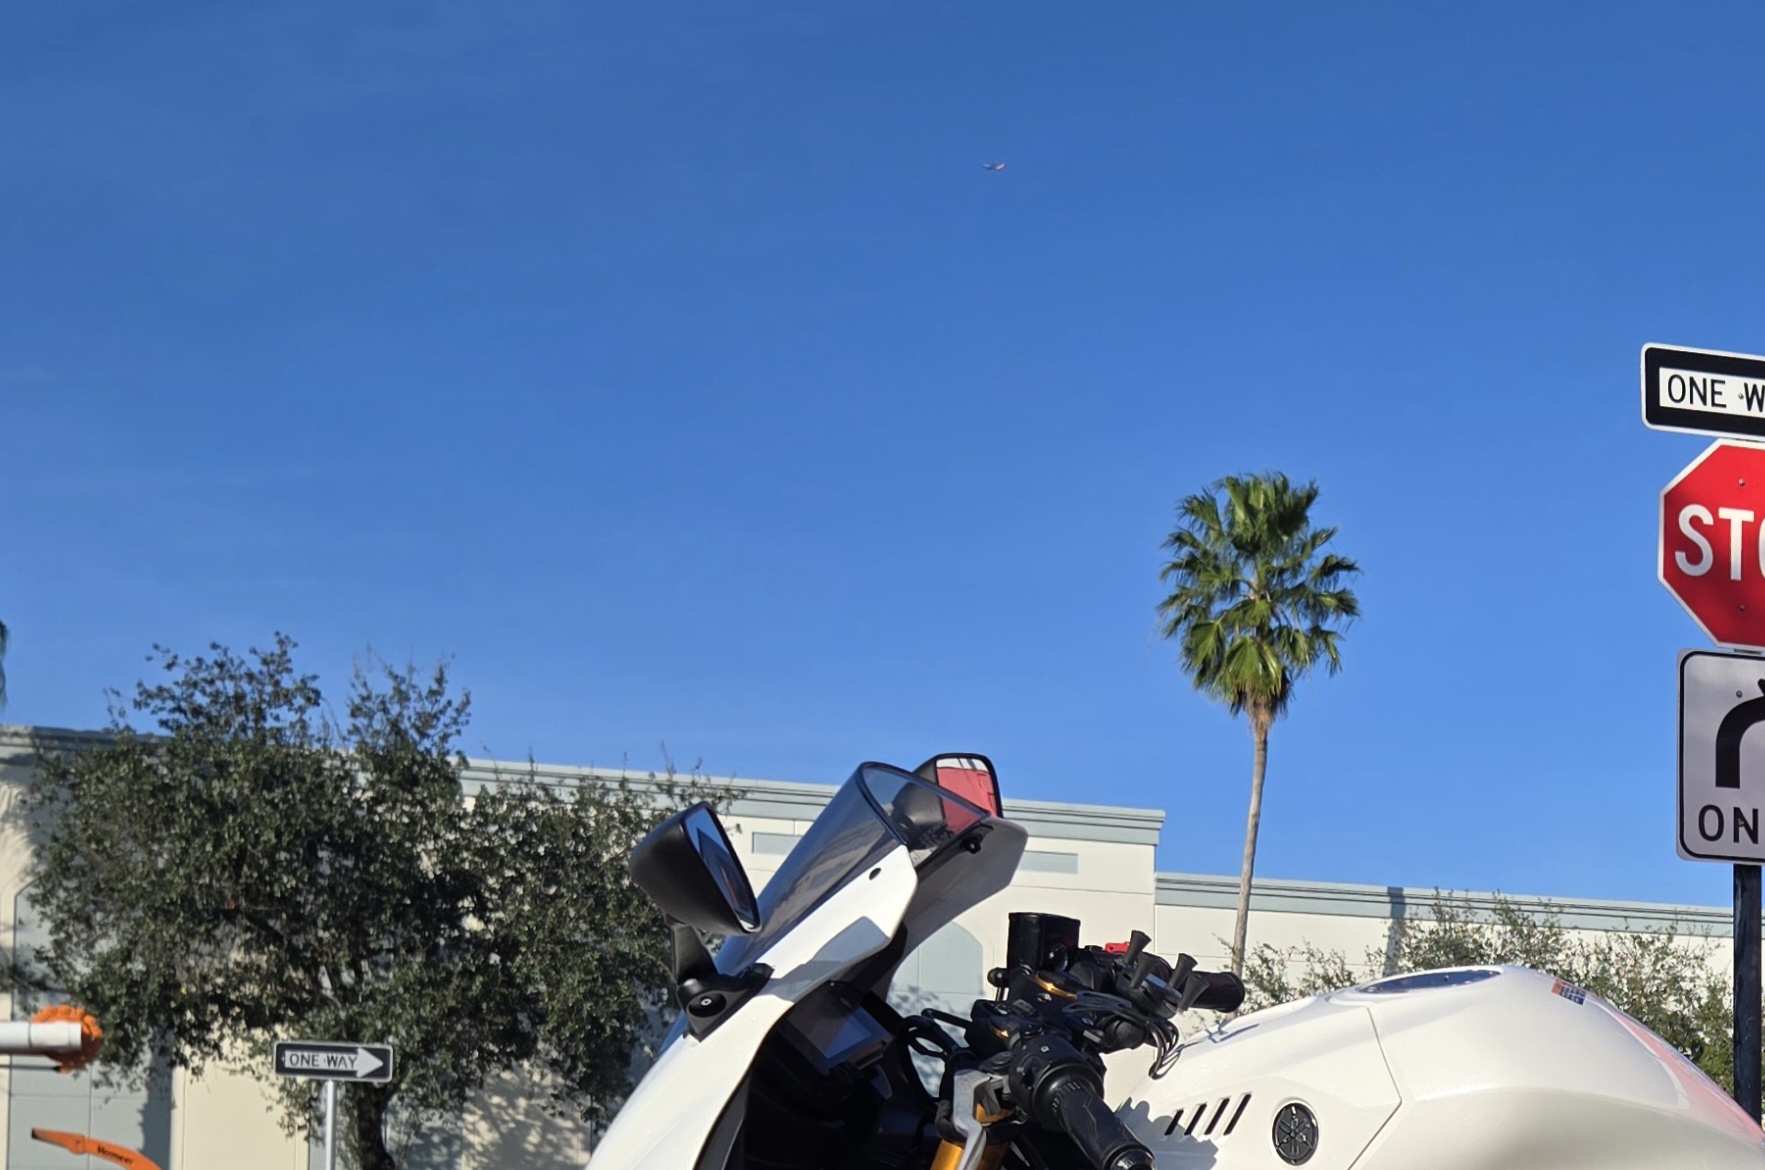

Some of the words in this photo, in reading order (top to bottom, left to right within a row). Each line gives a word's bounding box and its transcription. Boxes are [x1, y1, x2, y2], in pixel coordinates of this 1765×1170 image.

[1667, 374, 1728, 408] ONE
[289, 1053, 320, 1067] ONE
[327, 1054, 358, 1069] WAY
